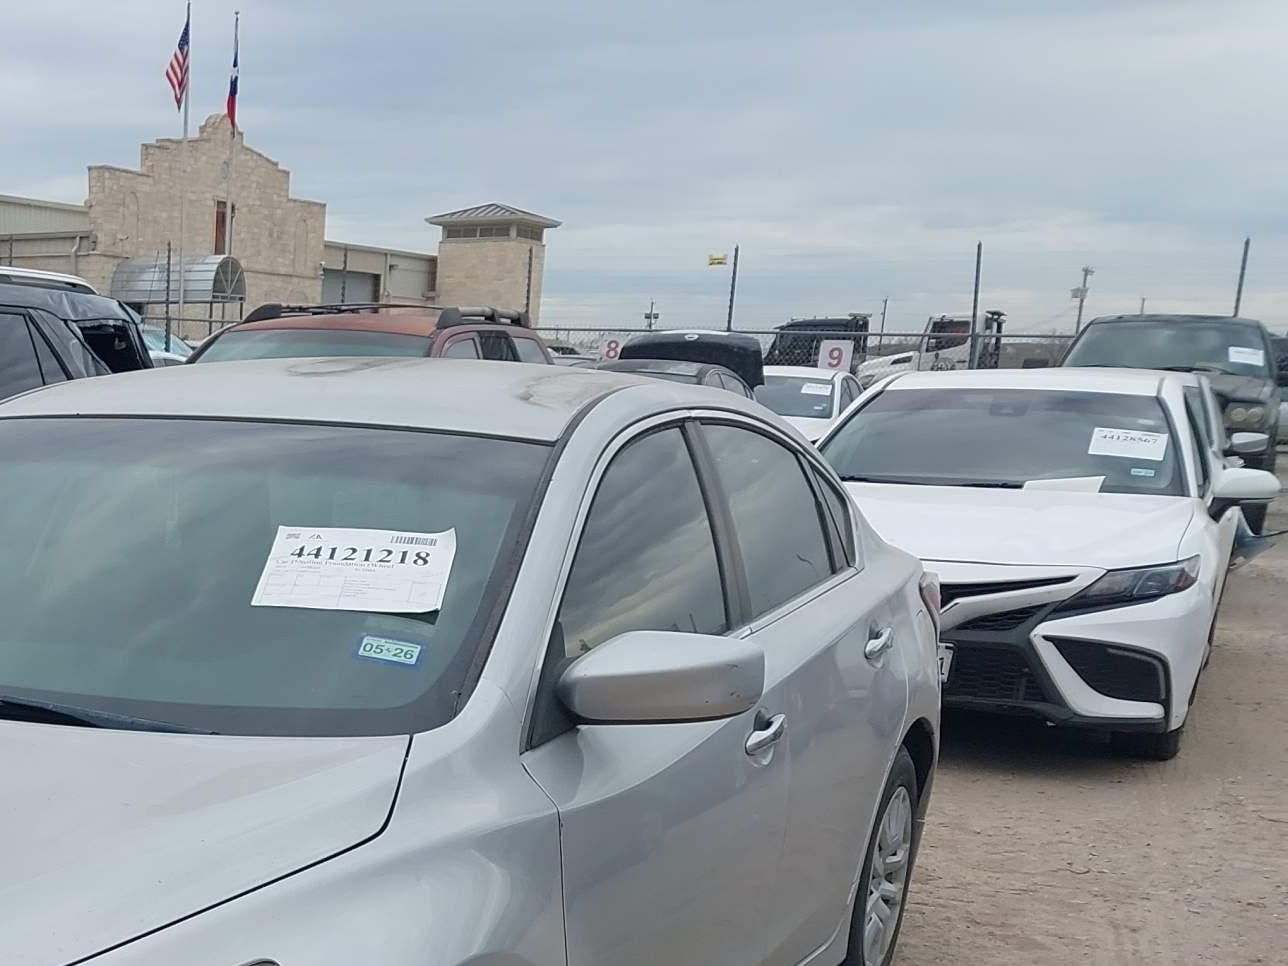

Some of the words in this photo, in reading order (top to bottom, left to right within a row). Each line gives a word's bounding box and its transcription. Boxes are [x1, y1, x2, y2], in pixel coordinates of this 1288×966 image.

[606, 340, 619, 359] 8
[828, 347, 843, 368] 9
[289, 545, 431, 567] 44121218
